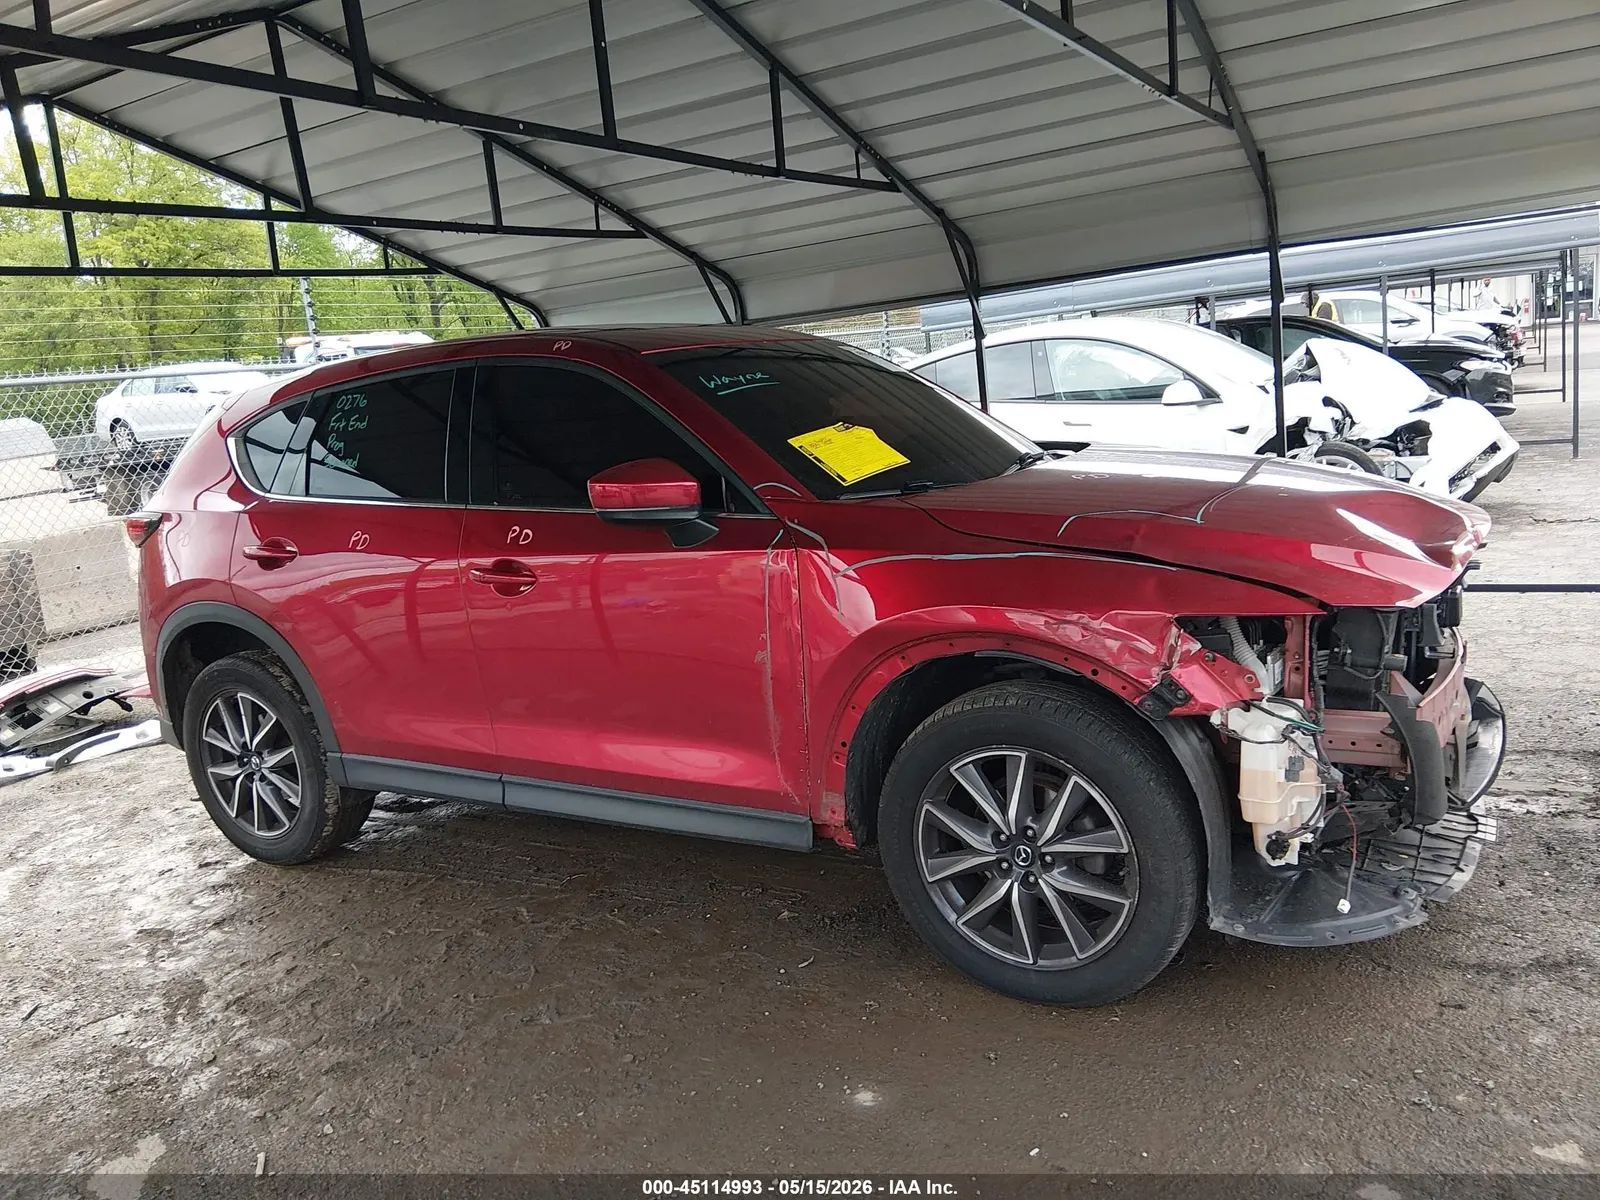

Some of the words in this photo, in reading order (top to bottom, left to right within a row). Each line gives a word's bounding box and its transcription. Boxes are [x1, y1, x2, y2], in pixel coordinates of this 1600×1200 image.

[553, 340, 572, 351] PD
[336, 394, 368, 410] 0276
[348, 414, 369, 431] End
[348, 530, 370, 550] PD
[507, 525, 533, 545] PD
